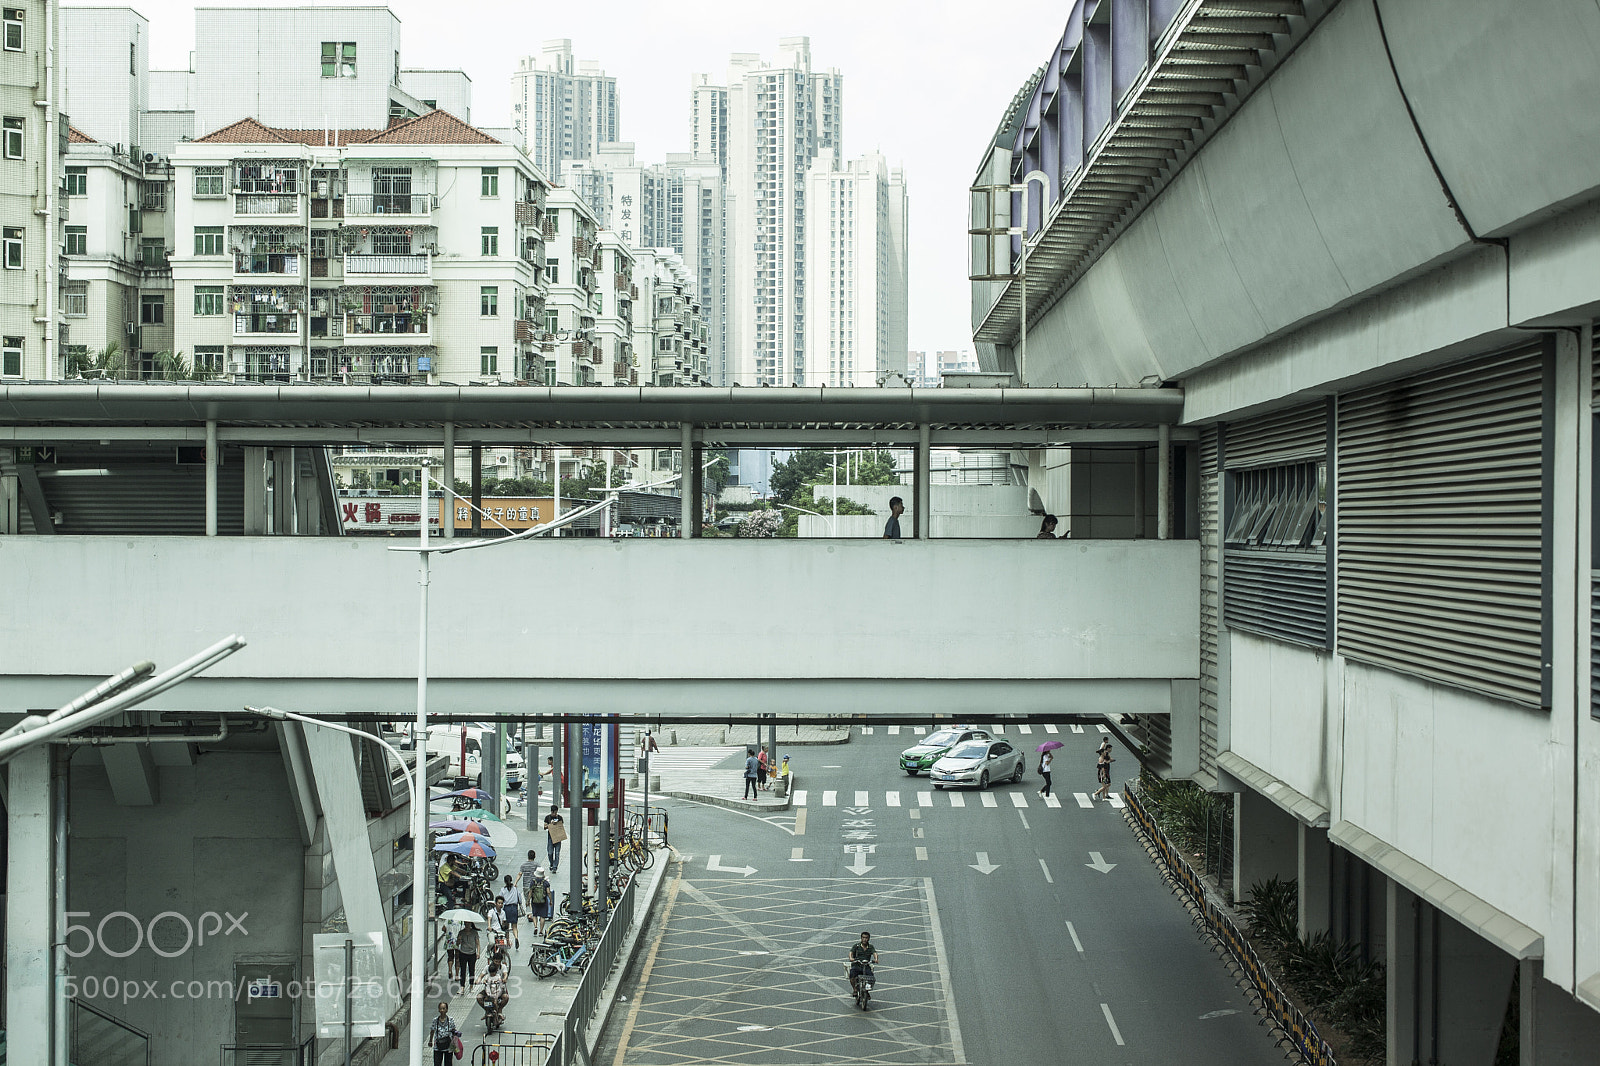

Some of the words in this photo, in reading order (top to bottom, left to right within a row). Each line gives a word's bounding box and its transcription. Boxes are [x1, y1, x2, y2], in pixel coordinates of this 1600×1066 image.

[343, 502, 381, 523] 火锅
[457, 507, 541, 521] 释孩子的童真
